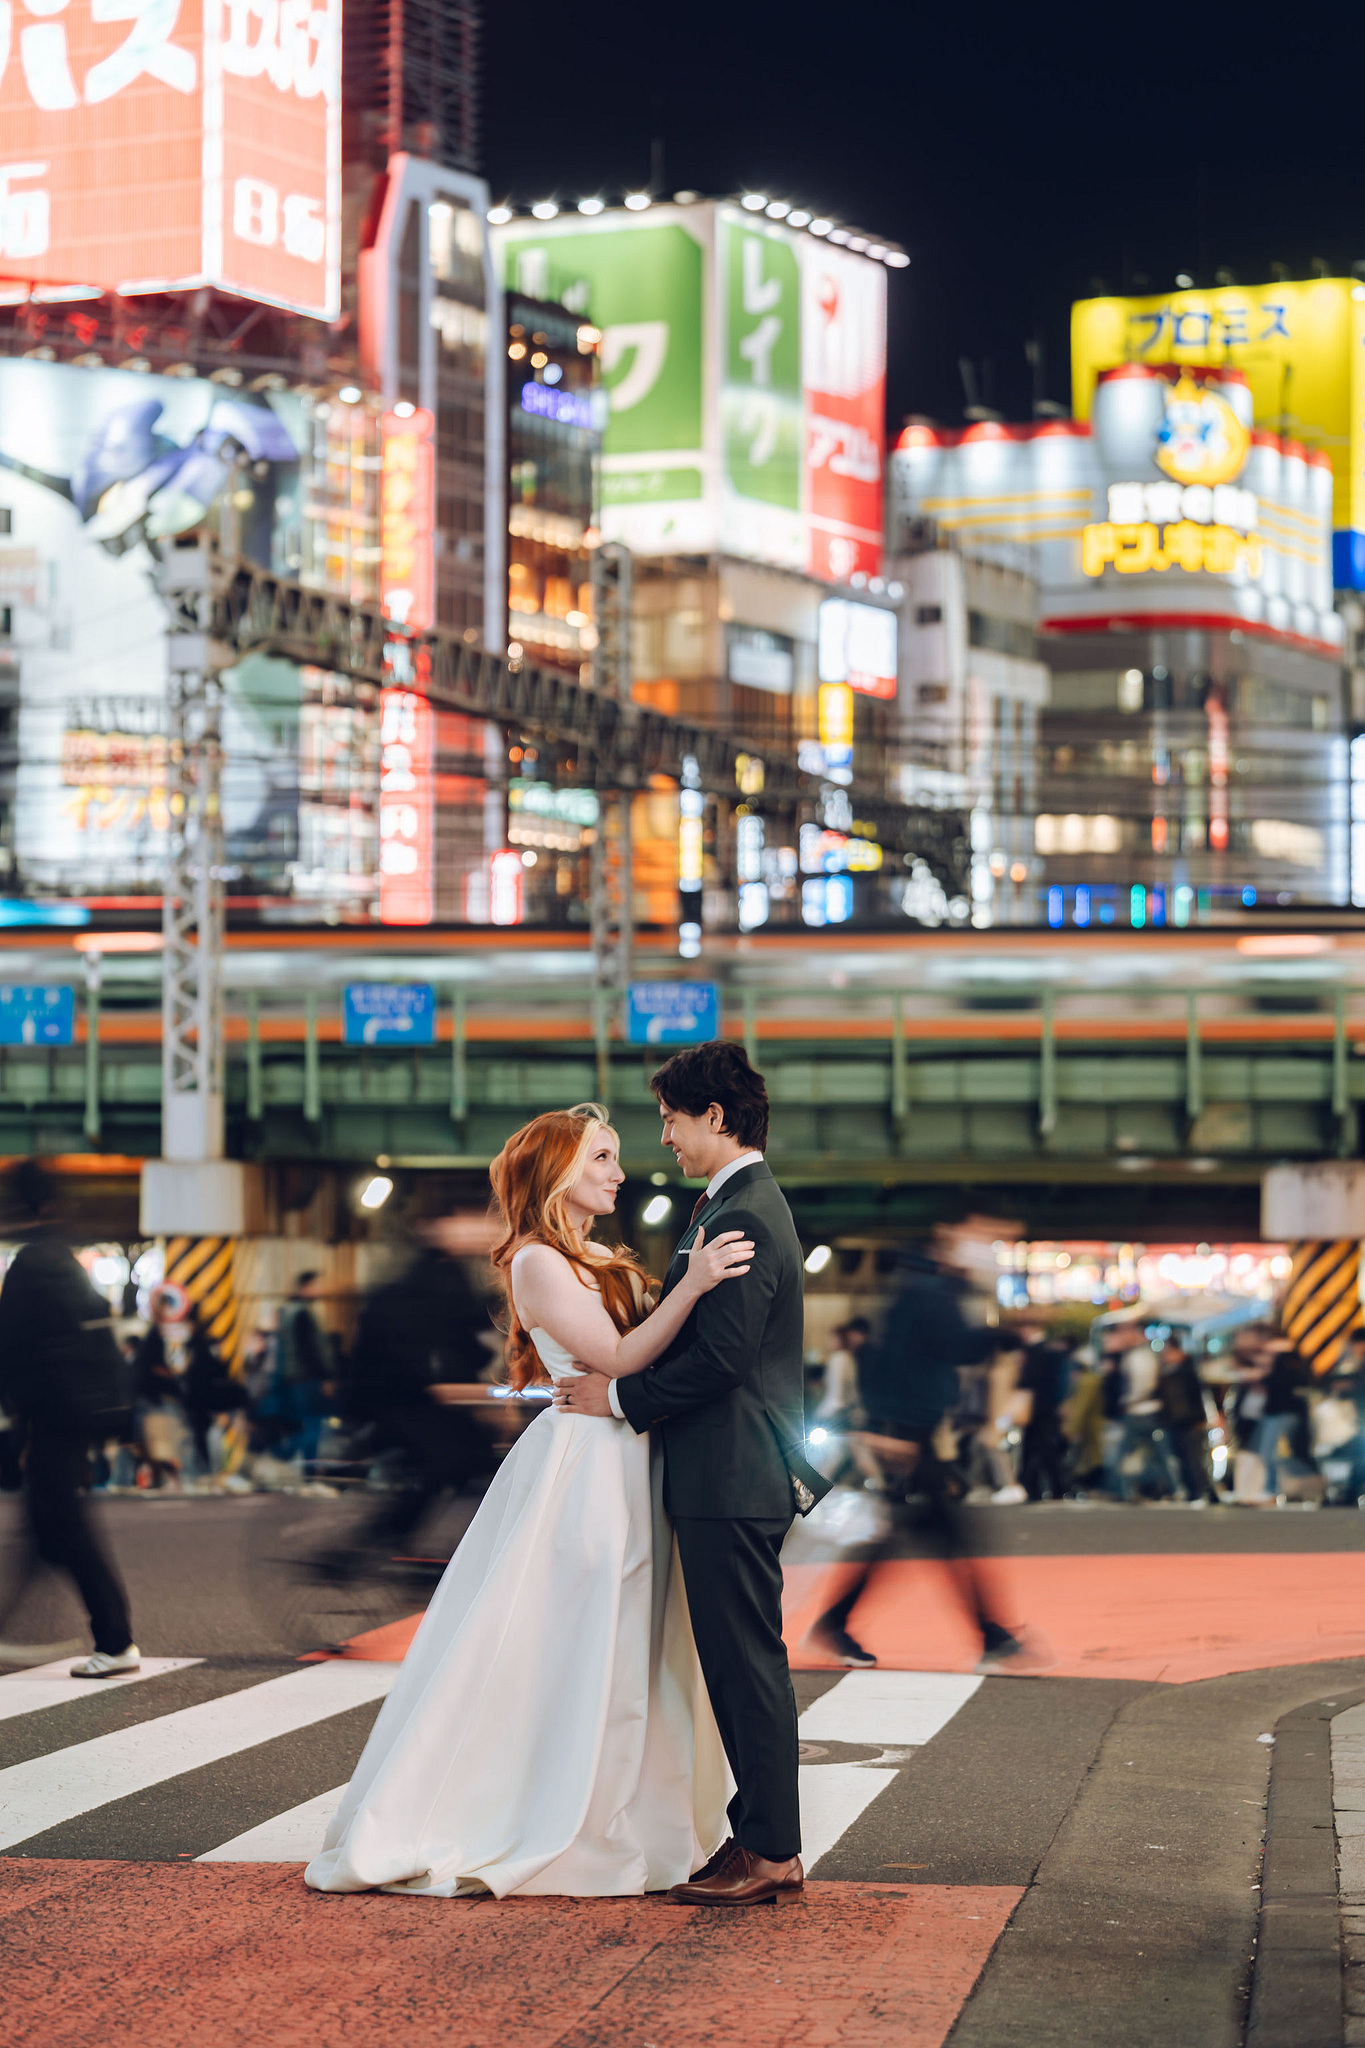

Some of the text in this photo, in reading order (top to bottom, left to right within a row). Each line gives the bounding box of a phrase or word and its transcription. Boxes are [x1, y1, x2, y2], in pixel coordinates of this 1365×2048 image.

[739, 237, 782, 467] レイク
[1130, 302, 1290, 354] プロミス
